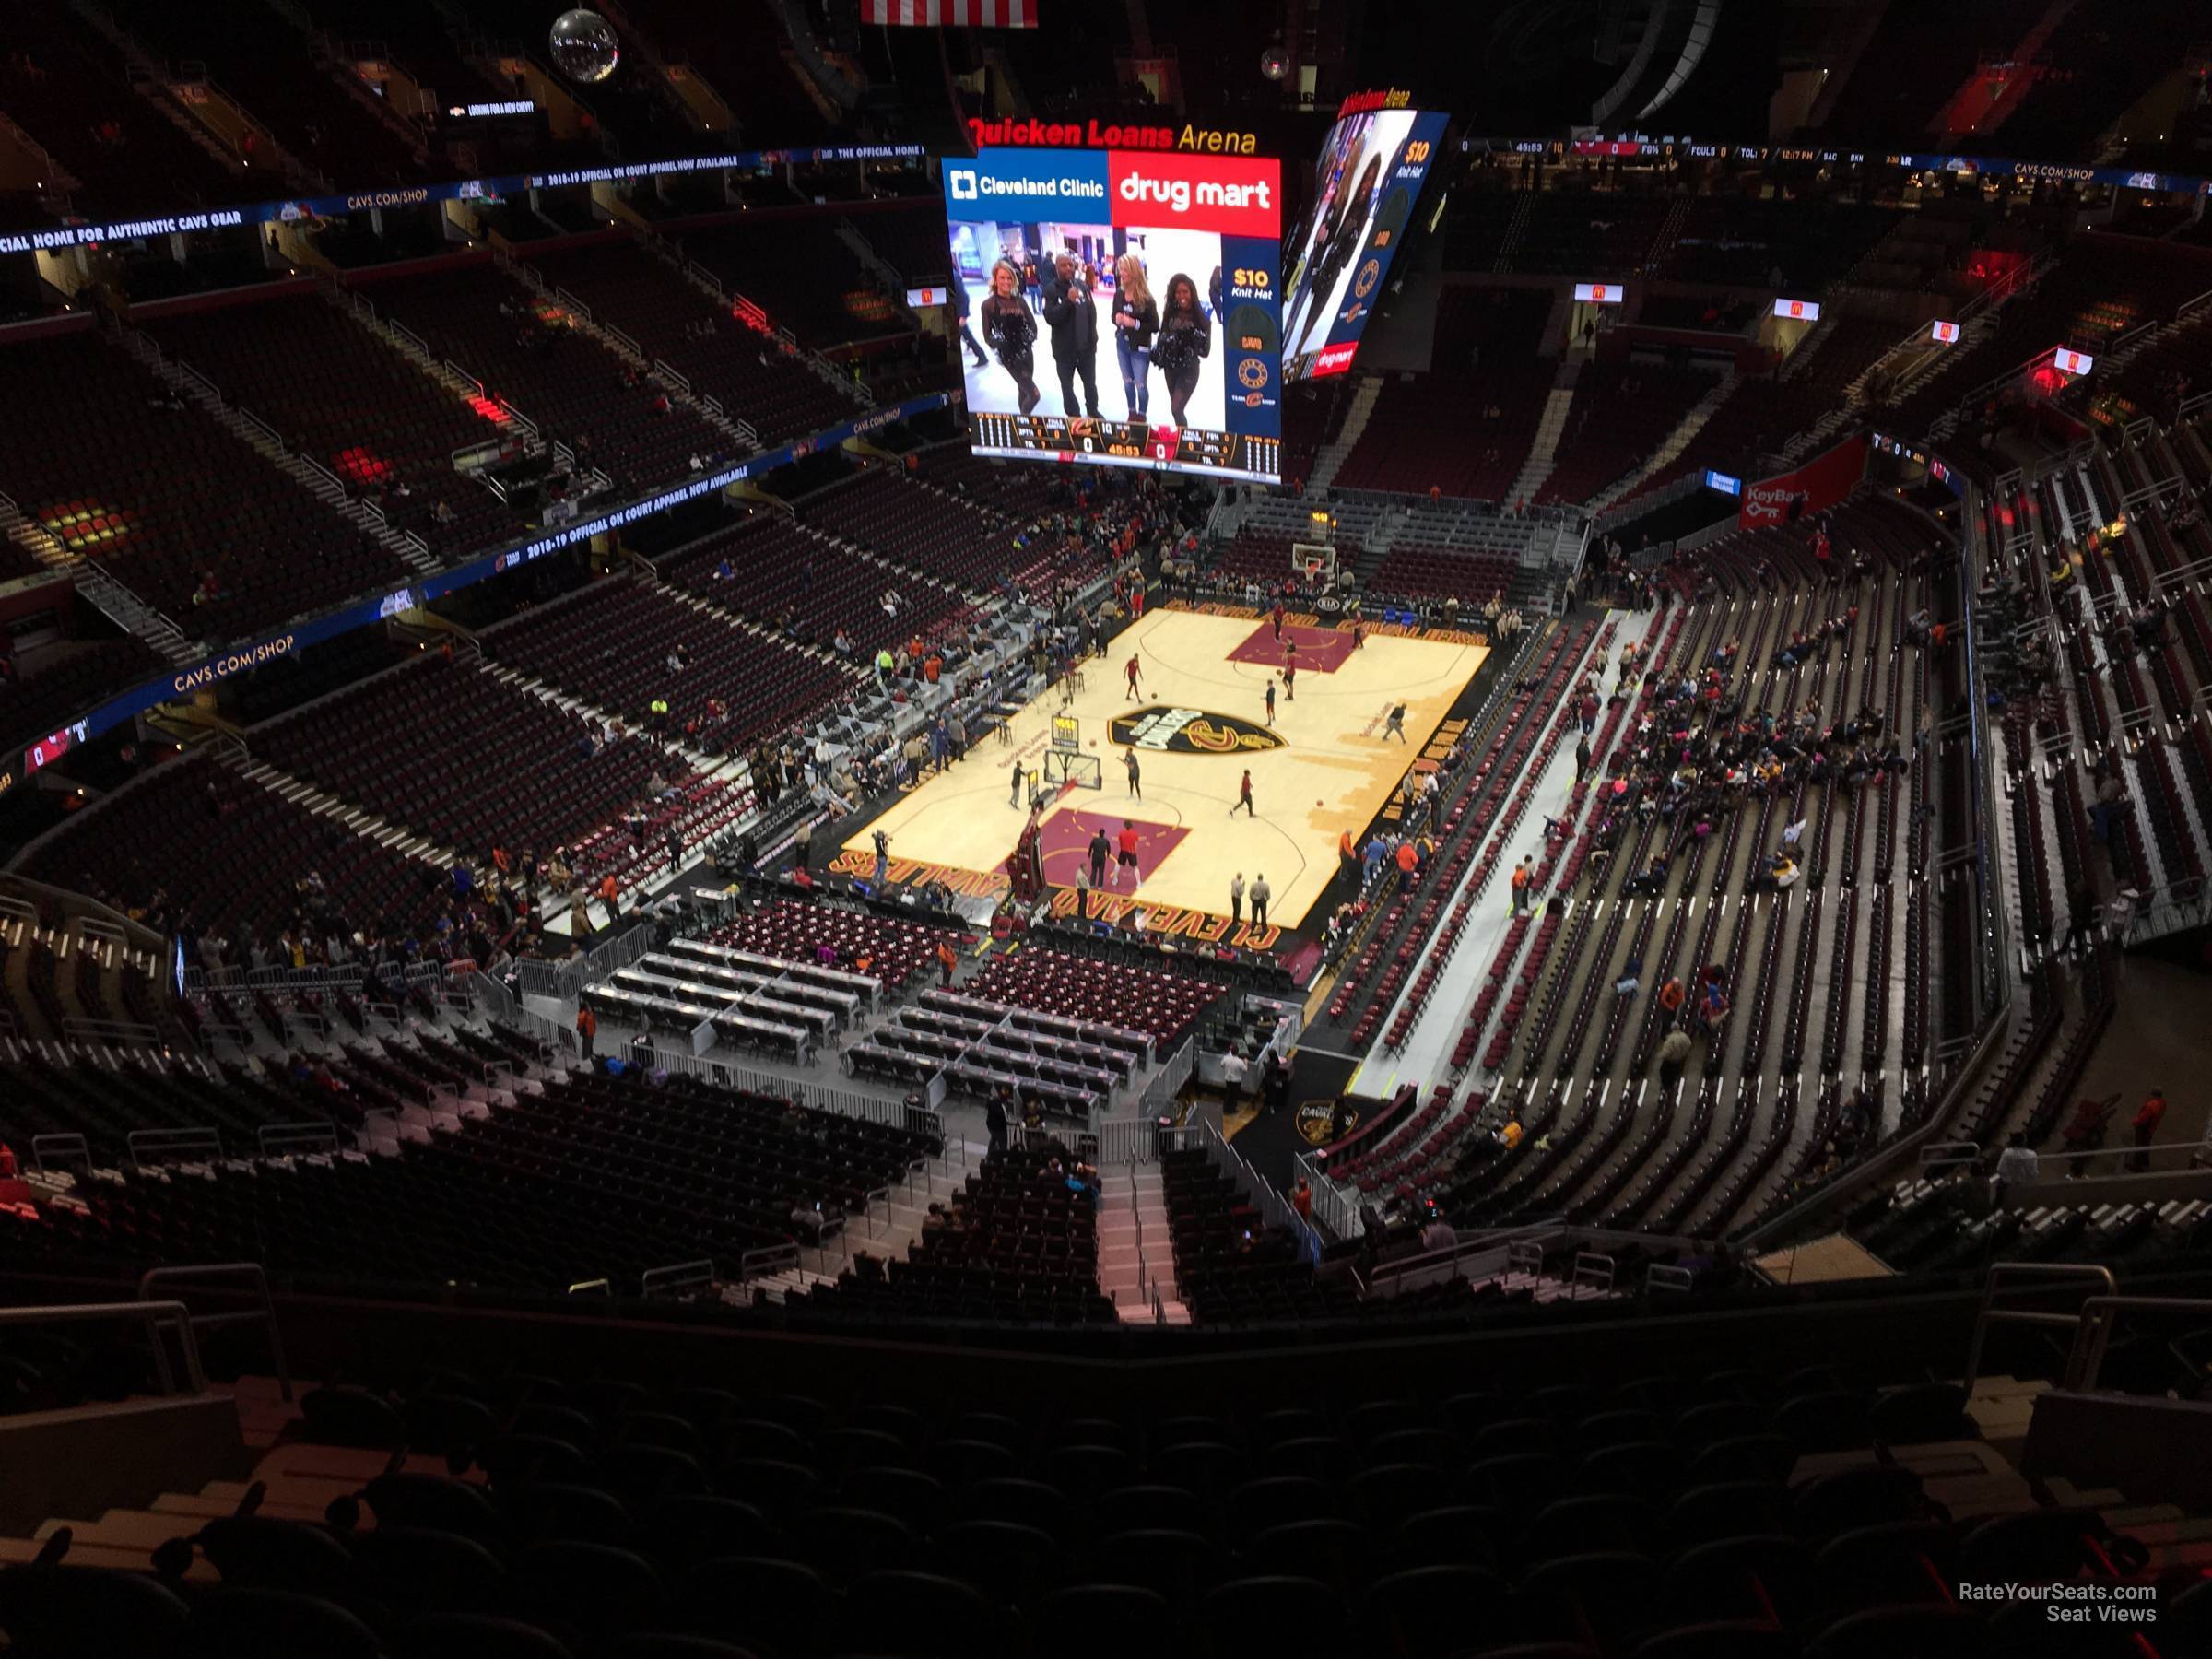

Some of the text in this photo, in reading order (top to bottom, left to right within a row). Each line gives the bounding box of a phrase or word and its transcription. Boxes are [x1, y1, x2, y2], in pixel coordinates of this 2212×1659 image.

[1088, 119, 1172, 149] Loans
[1179, 124, 1256, 154] Arena
[1462, 141, 1468, 151] 0
[838, 148, 854, 159] THE
[856, 147, 893, 158] OFFICIAL
[895, 146, 919, 156] HOME
[1406, 140, 1430, 164] $10
[1691, 146, 1716, 157] FOULS
[548, 171, 579, 185] 2018-19
[581, 169, 612, 182] OFFICIAL
[613, 167, 624, 178] ON
[626, 164, 647, 177] COURT
[649, 161, 677, 174] APPAREL
[677, 159, 694, 170] NOW
[696, 155, 737, 169] AVAILABLE
[2014, 162, 2094, 181] CAVS.COM/SHOP
[980, 176, 1104, 198] Cleveland Clinic
[1120, 171, 1270, 212] drug mart
[347, 188, 428, 210] CAVS.COM/SHOP
[33, 230, 75, 248] HOME
[77, 227, 104, 243] FOR
[108, 218, 176, 240] AUTHENTIC
[178, 215, 208, 230] CAVS
[212, 210, 241, 226] GEAR
[1234, 268, 1269, 288] $10
[1231, 287, 1273, 300] Knit Hat
[1083, 437, 1093, 453] 0
[1156, 443, 1166, 459] 0
[527, 465, 747, 559] 2018-19 OFFICIAL ON COURT APPAREL NOW AVAILABLE
[174, 634, 294, 692] CAVS.COM/SHOP
[34, 747, 44, 767] 0
